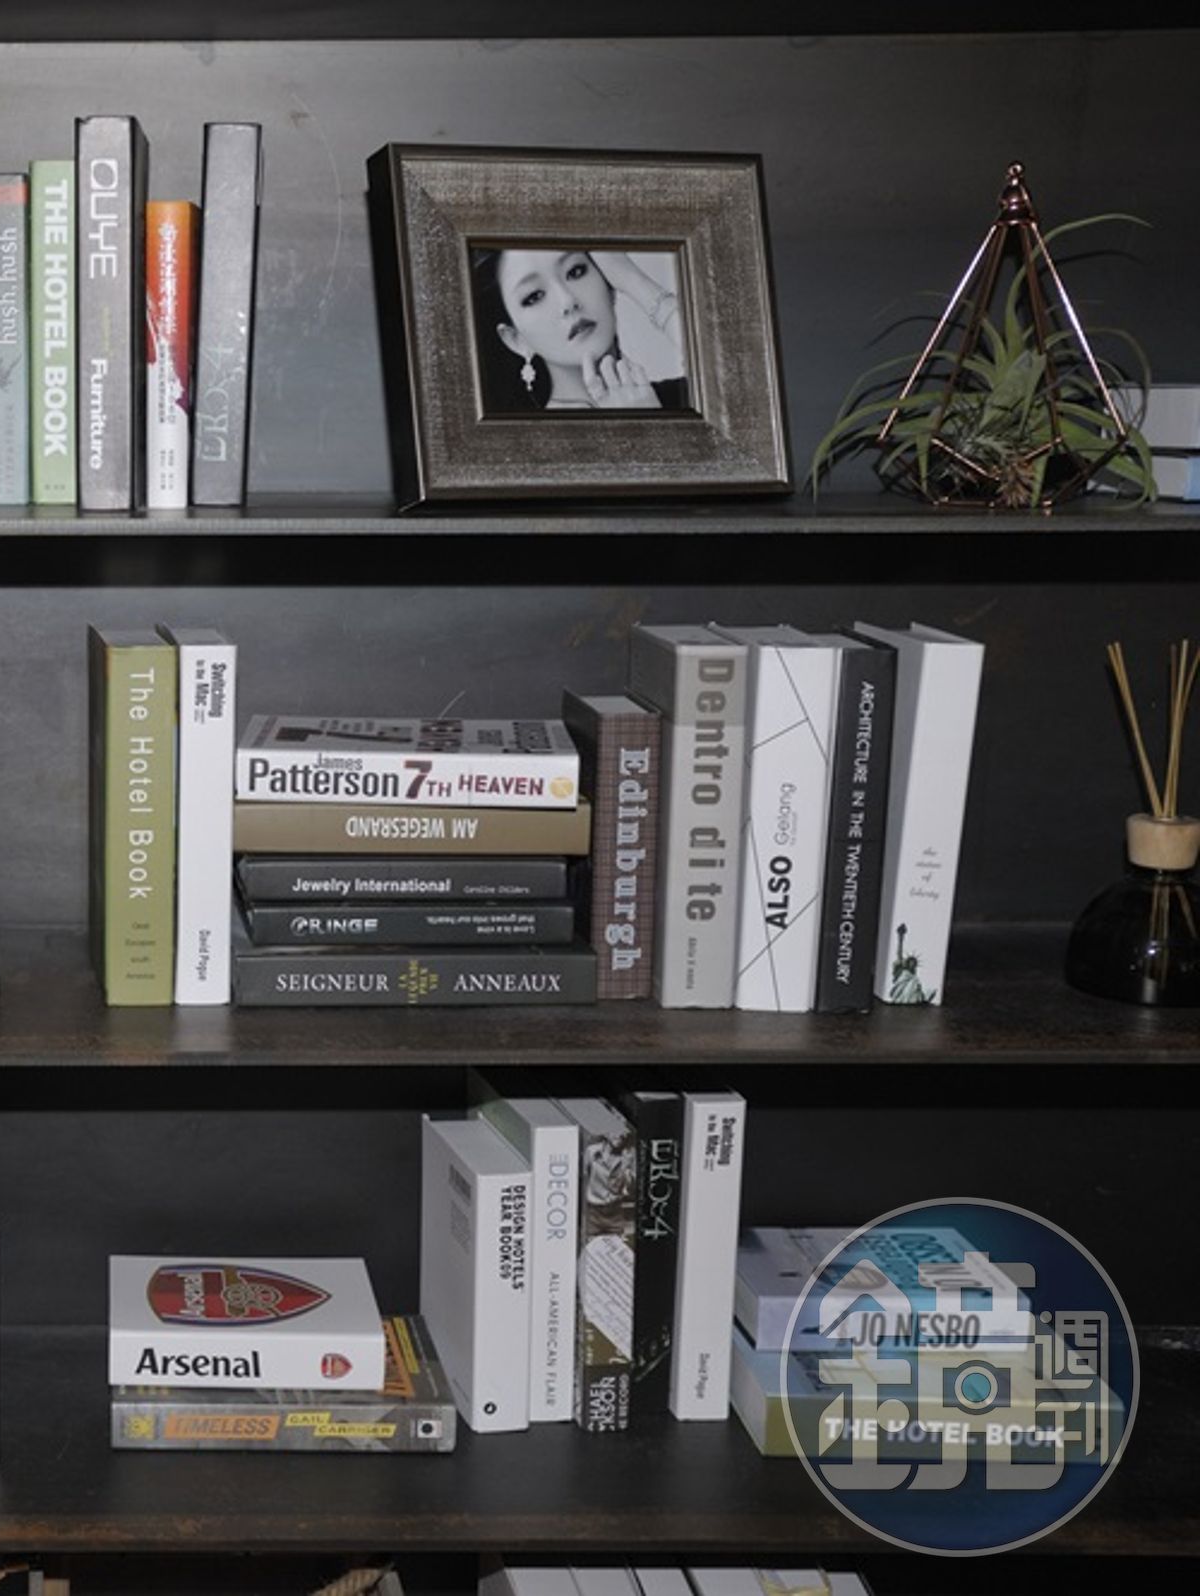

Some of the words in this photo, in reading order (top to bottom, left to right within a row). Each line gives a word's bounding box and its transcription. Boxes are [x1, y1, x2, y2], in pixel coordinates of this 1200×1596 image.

[43, 179, 68, 244] THE
[43, 253, 68, 358] HOTEL
[42, 363, 68, 458] BOOK
[89, 357, 109, 470] Furniture
[129, 667, 155, 721] The
[195, 683, 210, 707] Mac
[208, 662, 228, 719] Switching
[692, 657, 735, 806] Dentro
[853, 680, 875, 784] ARCHITECTURE
[129, 737, 154, 813] Hotel
[248, 757, 400, 798] Patterson
[312, 753, 364, 771] James
[457, 774, 545, 797] HEAVEN
[852, 790, 866, 807] IN
[344, 816, 446, 839] WEGESRAND
[452, 818, 479, 838] AM
[848, 812, 864, 838] THE
[128, 829, 154, 900] Book
[605, 747, 651, 970] Edinburgh
[292, 877, 351, 896] Jewelry
[354, 877, 452, 893] International
[765, 855, 793, 930] ALSO
[841, 844, 862, 919] TWENTIETH
[836, 920, 855, 985] CENTURY
[275, 973, 390, 993] SEIGNEUR
[453, 974, 562, 993] ANNEAUX
[717, 1117, 737, 1166] Switching
[500, 1187, 513, 1221] YEAR
[512, 1184, 527, 1234] DESIGN
[511, 1238, 525, 1291] HOTELS
[853, 1312, 887, 1348] JO
[893, 1312, 982, 1349] NESBO
[134, 1347, 261, 1378] Arsenal
[545, 1372, 557, 1406] FLAIR
[171, 1416, 272, 1436] TIMELESS
[824, 1416, 879, 1442] THE
[886, 1418, 977, 1446] HOTEL
[985, 1421, 1066, 1448] BOOK
